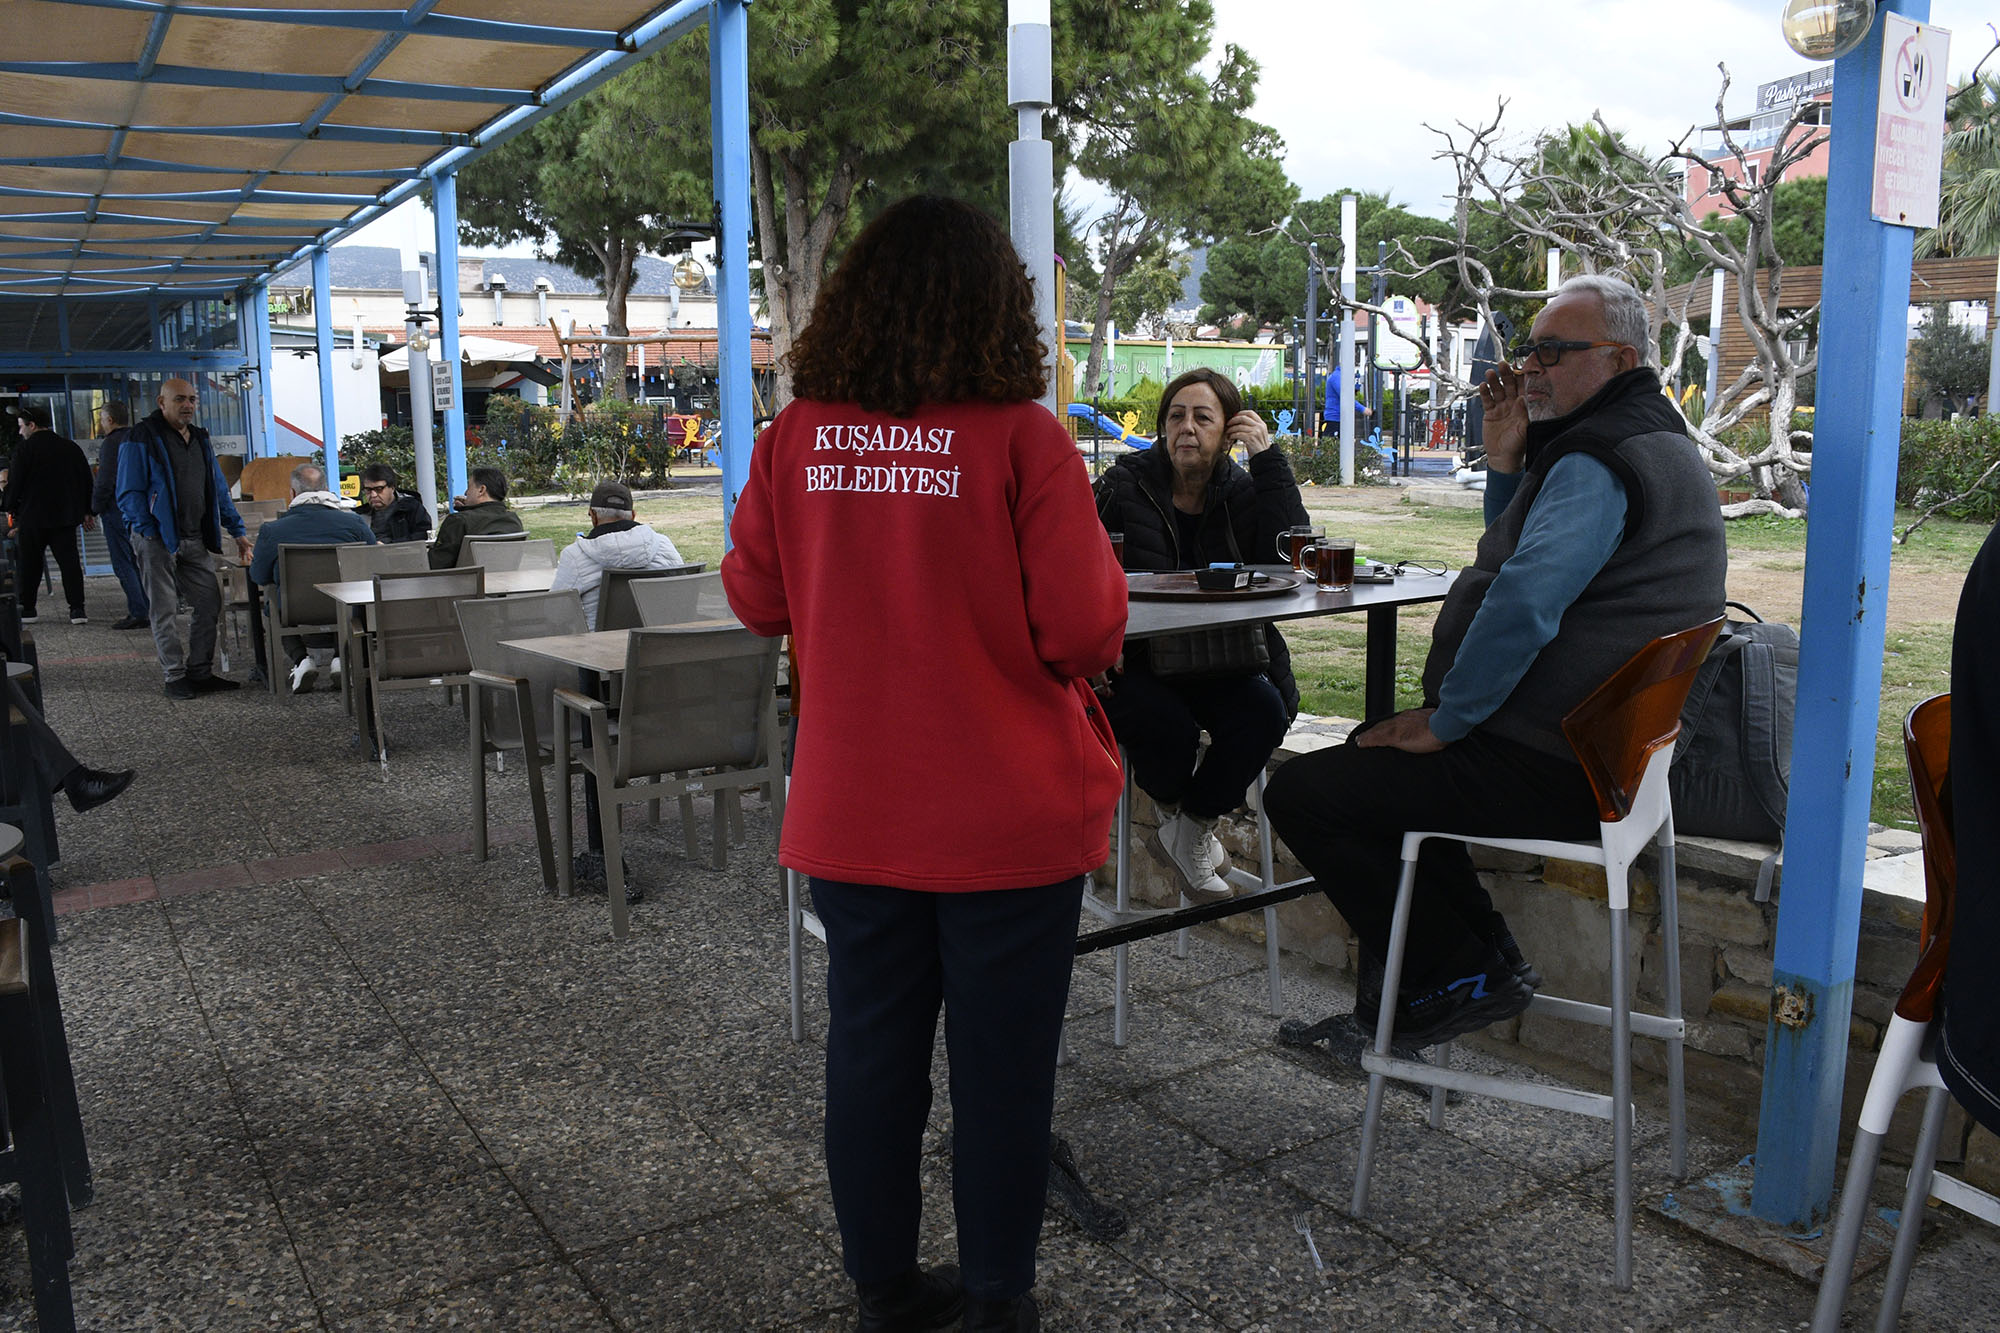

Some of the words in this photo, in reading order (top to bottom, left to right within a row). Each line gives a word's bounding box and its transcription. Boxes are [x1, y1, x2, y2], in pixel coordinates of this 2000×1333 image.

[1764, 81, 1802, 105] Pasha
[813, 424, 955, 456] KUŞADASI
[805, 460, 961, 498] BELEDİYESİ
